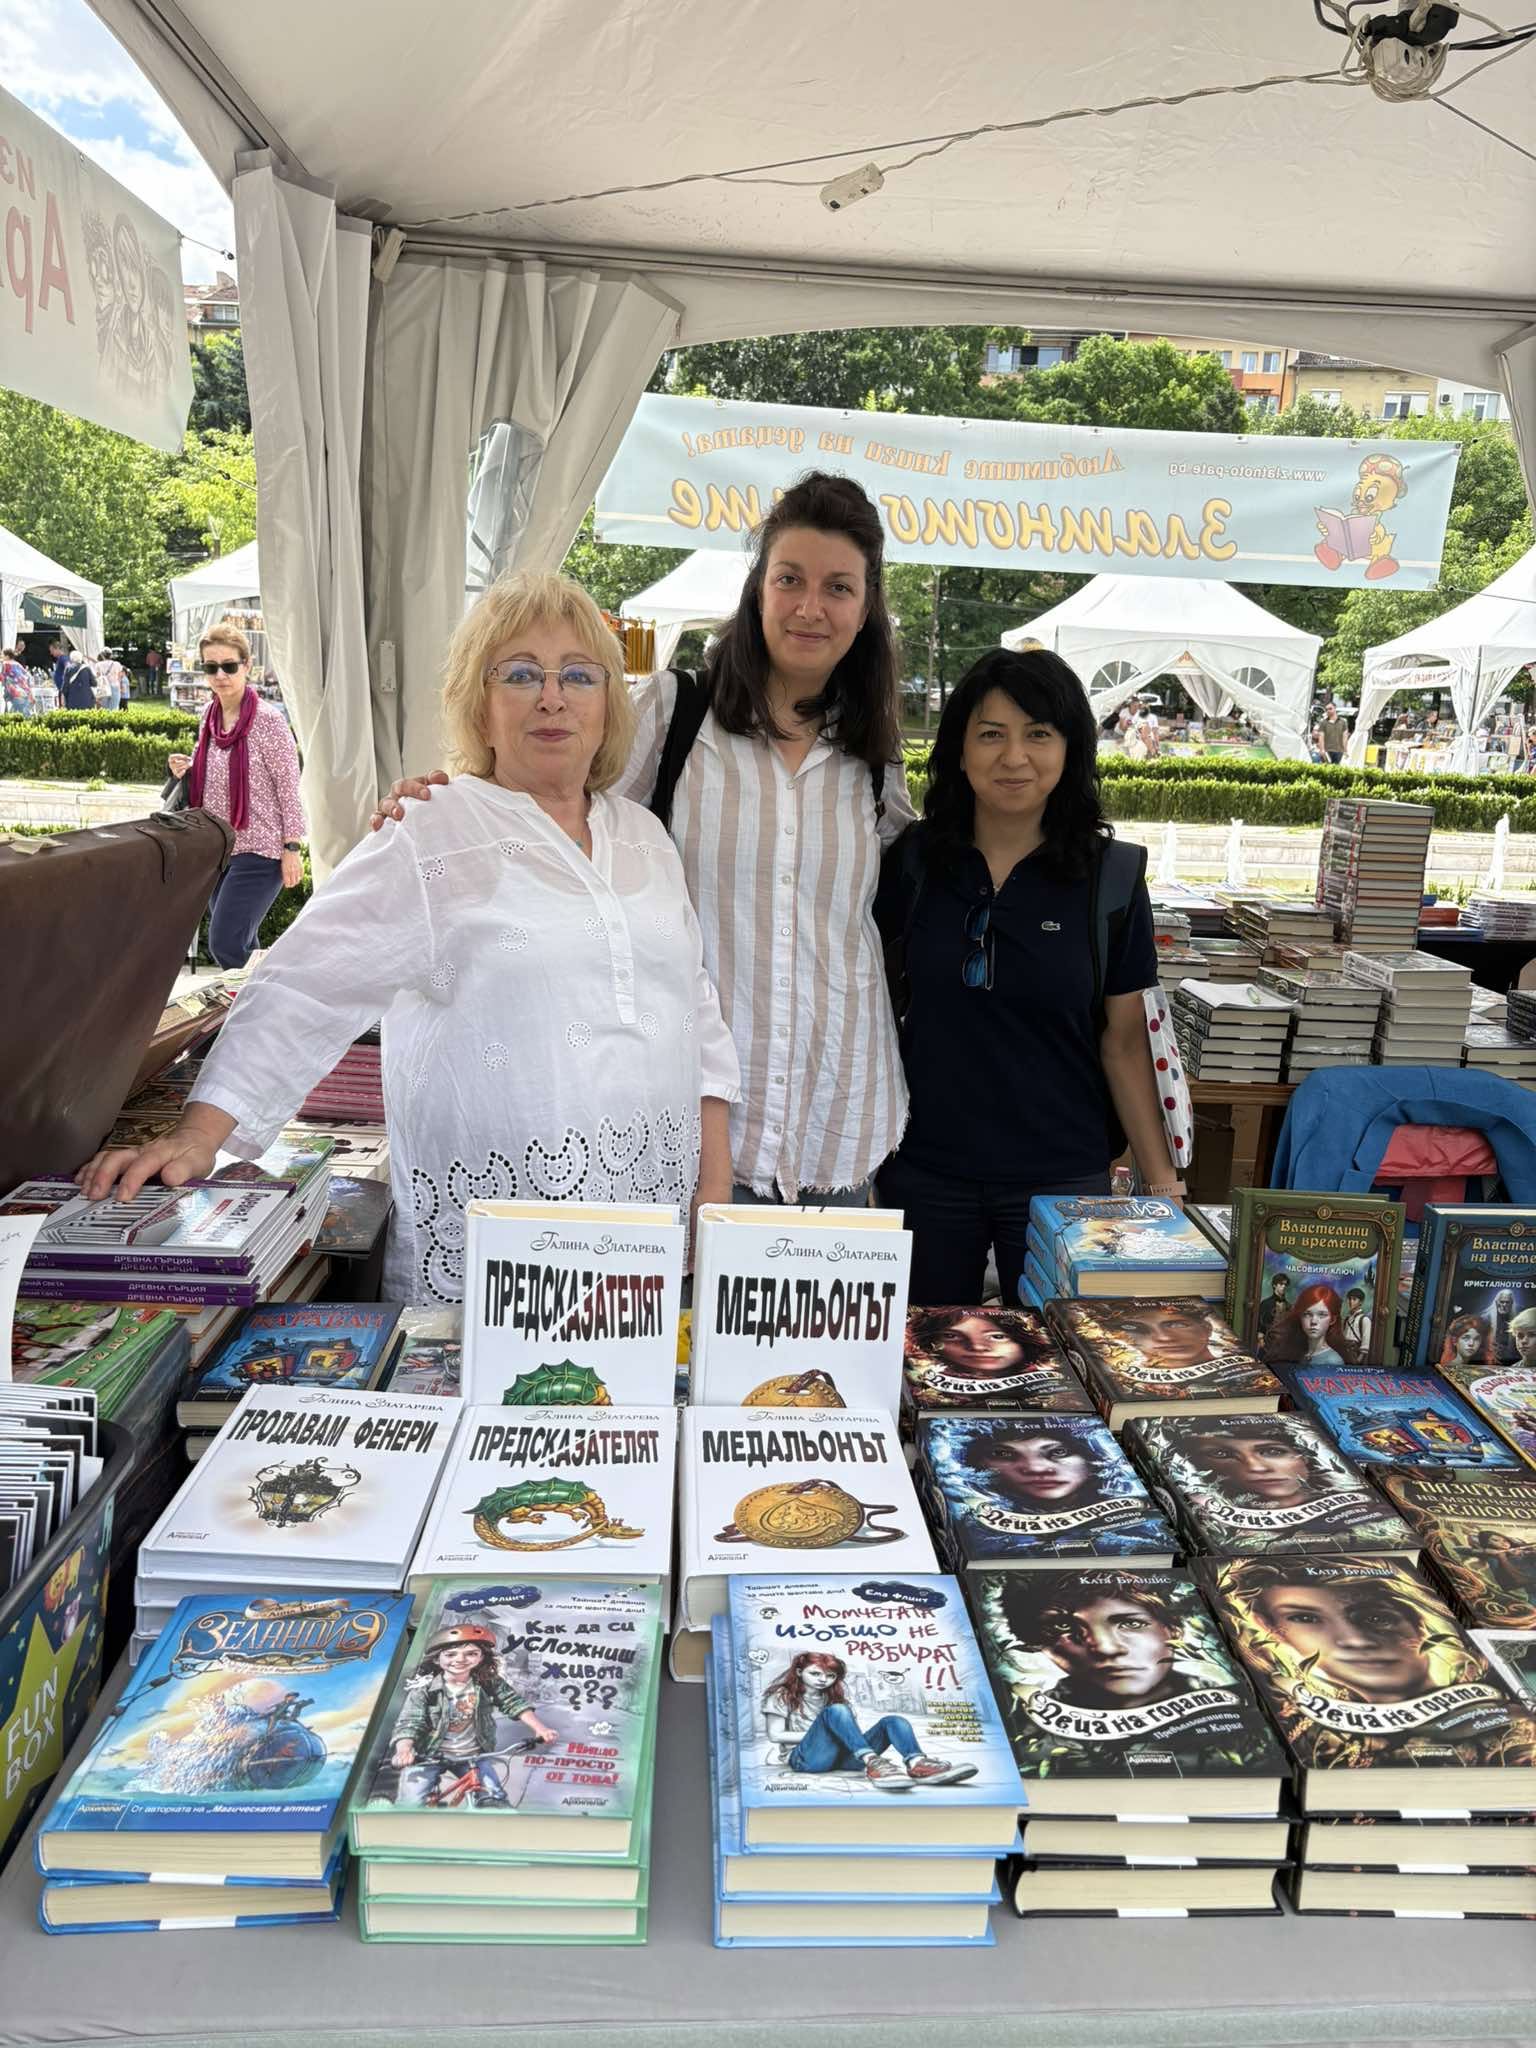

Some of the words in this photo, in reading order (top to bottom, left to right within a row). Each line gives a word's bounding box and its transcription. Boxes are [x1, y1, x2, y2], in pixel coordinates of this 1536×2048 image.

[1280, 1219, 1369, 1237] Властелини
[530, 1231, 590, 1251] ГАЛИНА
[593, 1234, 666, 1255] ЗЛАТАРЕВА
[765, 1238, 823, 1258] ГАЛИНА
[826, 1241, 898, 1262] ЗЛАТАРЕВА
[1279, 1235, 1296, 1245] на
[1302, 1237, 1368, 1249] времето
[1472, 1238, 1535, 1250] Властел
[113, 1255, 151, 1264] ДРЕВНА
[154, 1256, 193, 1265] ГЪРЦИЯ
[1471, 1253, 1487, 1262] на
[1330, 1267, 1355, 1276] КЛЮЧ
[1464, 1280, 1522, 1288] КРИСТАЛНОТО
[484, 1259, 664, 1342] ПРЕДСКАЗАТЕЛЯТ
[715, 1273, 896, 1348] МЕДАЛЬОНЪТ
[1126, 1365, 1173, 1382] Деца
[1176, 1370, 1196, 1380] на
[1197, 1356, 1245, 1374] гората
[928, 1373, 976, 1392] Деца
[978, 1381, 1000, 1391] на
[1001, 1372, 1054, 1386] гората
[1302, 1375, 1443, 1396] КАРАВАН
[227, 1409, 350, 1447] ПРОДАВАМ
[353, 1417, 438, 1453] ФЕНЕРИ
[1014, 1421, 1041, 1431] КАТЯ
[469, 1425, 659, 1468] ПРЕДСКАЗАТЕЛЯТ
[702, 1430, 888, 1468] МЕДАЛЬОНЪТ
[979, 1510, 1042, 1533] Деца
[1044, 1517, 1070, 1529] на
[1071, 1500, 1131, 1521] гората
[1211, 1506, 1274, 1528] Деца
[1276, 1511, 1303, 1524] на
[1300, 1493, 1359, 1517] гората
[1079, 1576, 1112, 1585] КАТЯ
[1116, 1576, 1172, 1585] БРАНДИС
[1305, 1567, 1339, 1576] КАТЯ
[1343, 1567, 1398, 1577] БРАНДИС
[460, 1599, 485, 1607] Ема
[864, 1588, 888, 1598] Ема
[526, 1620, 567, 1635] Как
[574, 1621, 600, 1635] да
[607, 1620, 636, 1633] си
[775, 1623, 897, 1642] ИЗОБЩО
[909, 1624, 939, 1638] НЕ
[845, 1640, 958, 1663] РАЗБИРАТ
[924, 1664, 963, 1691] !!!
[560, 1679, 618, 1711] ???
[6, 1666, 59, 1763] FUN
[1032, 1703, 1110, 1737] Деца
[1112, 1714, 1149, 1732] на
[1147, 1690, 1225, 1723] гората
[1301, 1696, 1380, 1730] Деца
[1381, 1708, 1418, 1727] на
[1415, 1685, 1486, 1717] гората
[5, 1702, 57, 1800] BOX
